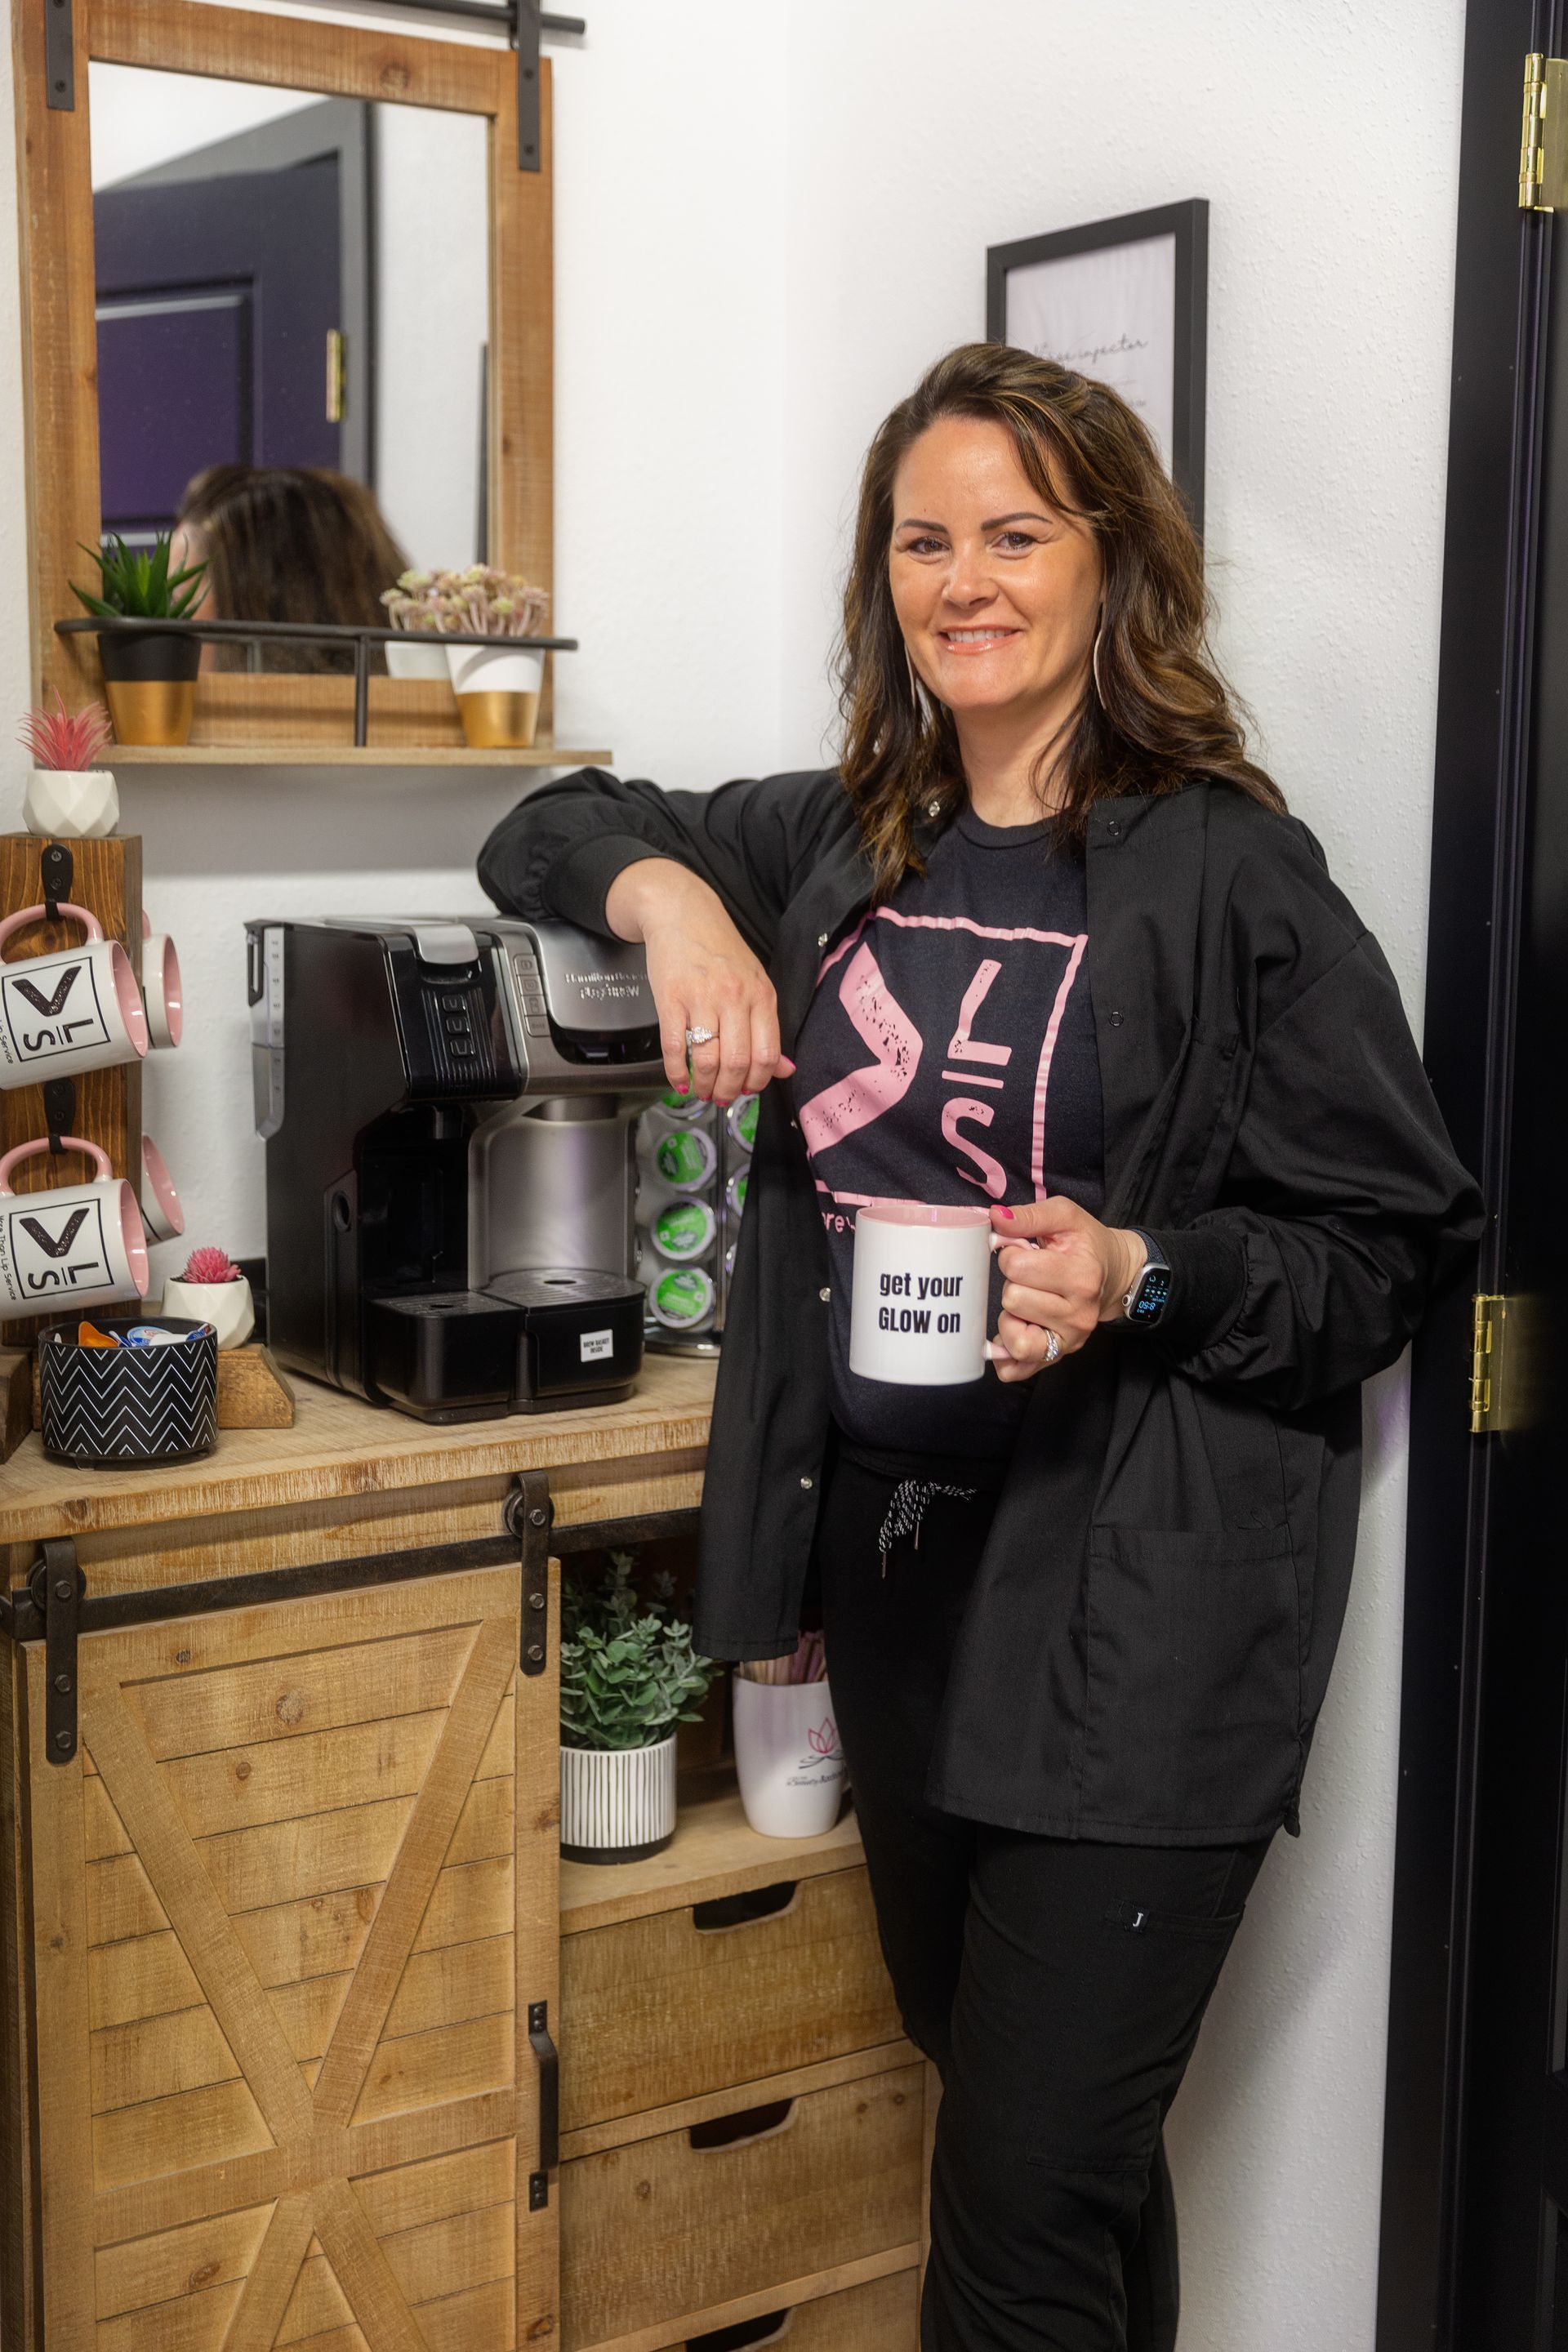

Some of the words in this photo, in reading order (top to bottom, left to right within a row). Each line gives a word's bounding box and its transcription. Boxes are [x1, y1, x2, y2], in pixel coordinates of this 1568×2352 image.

[1, 1035, 14, 1064] Service
[4, 1272, 17, 1301] Service
[880, 1272, 911, 1297] get
[917, 1276, 964, 1300] your
[878, 1306, 932, 1334] GLOW
[937, 1312, 961, 1334] on
